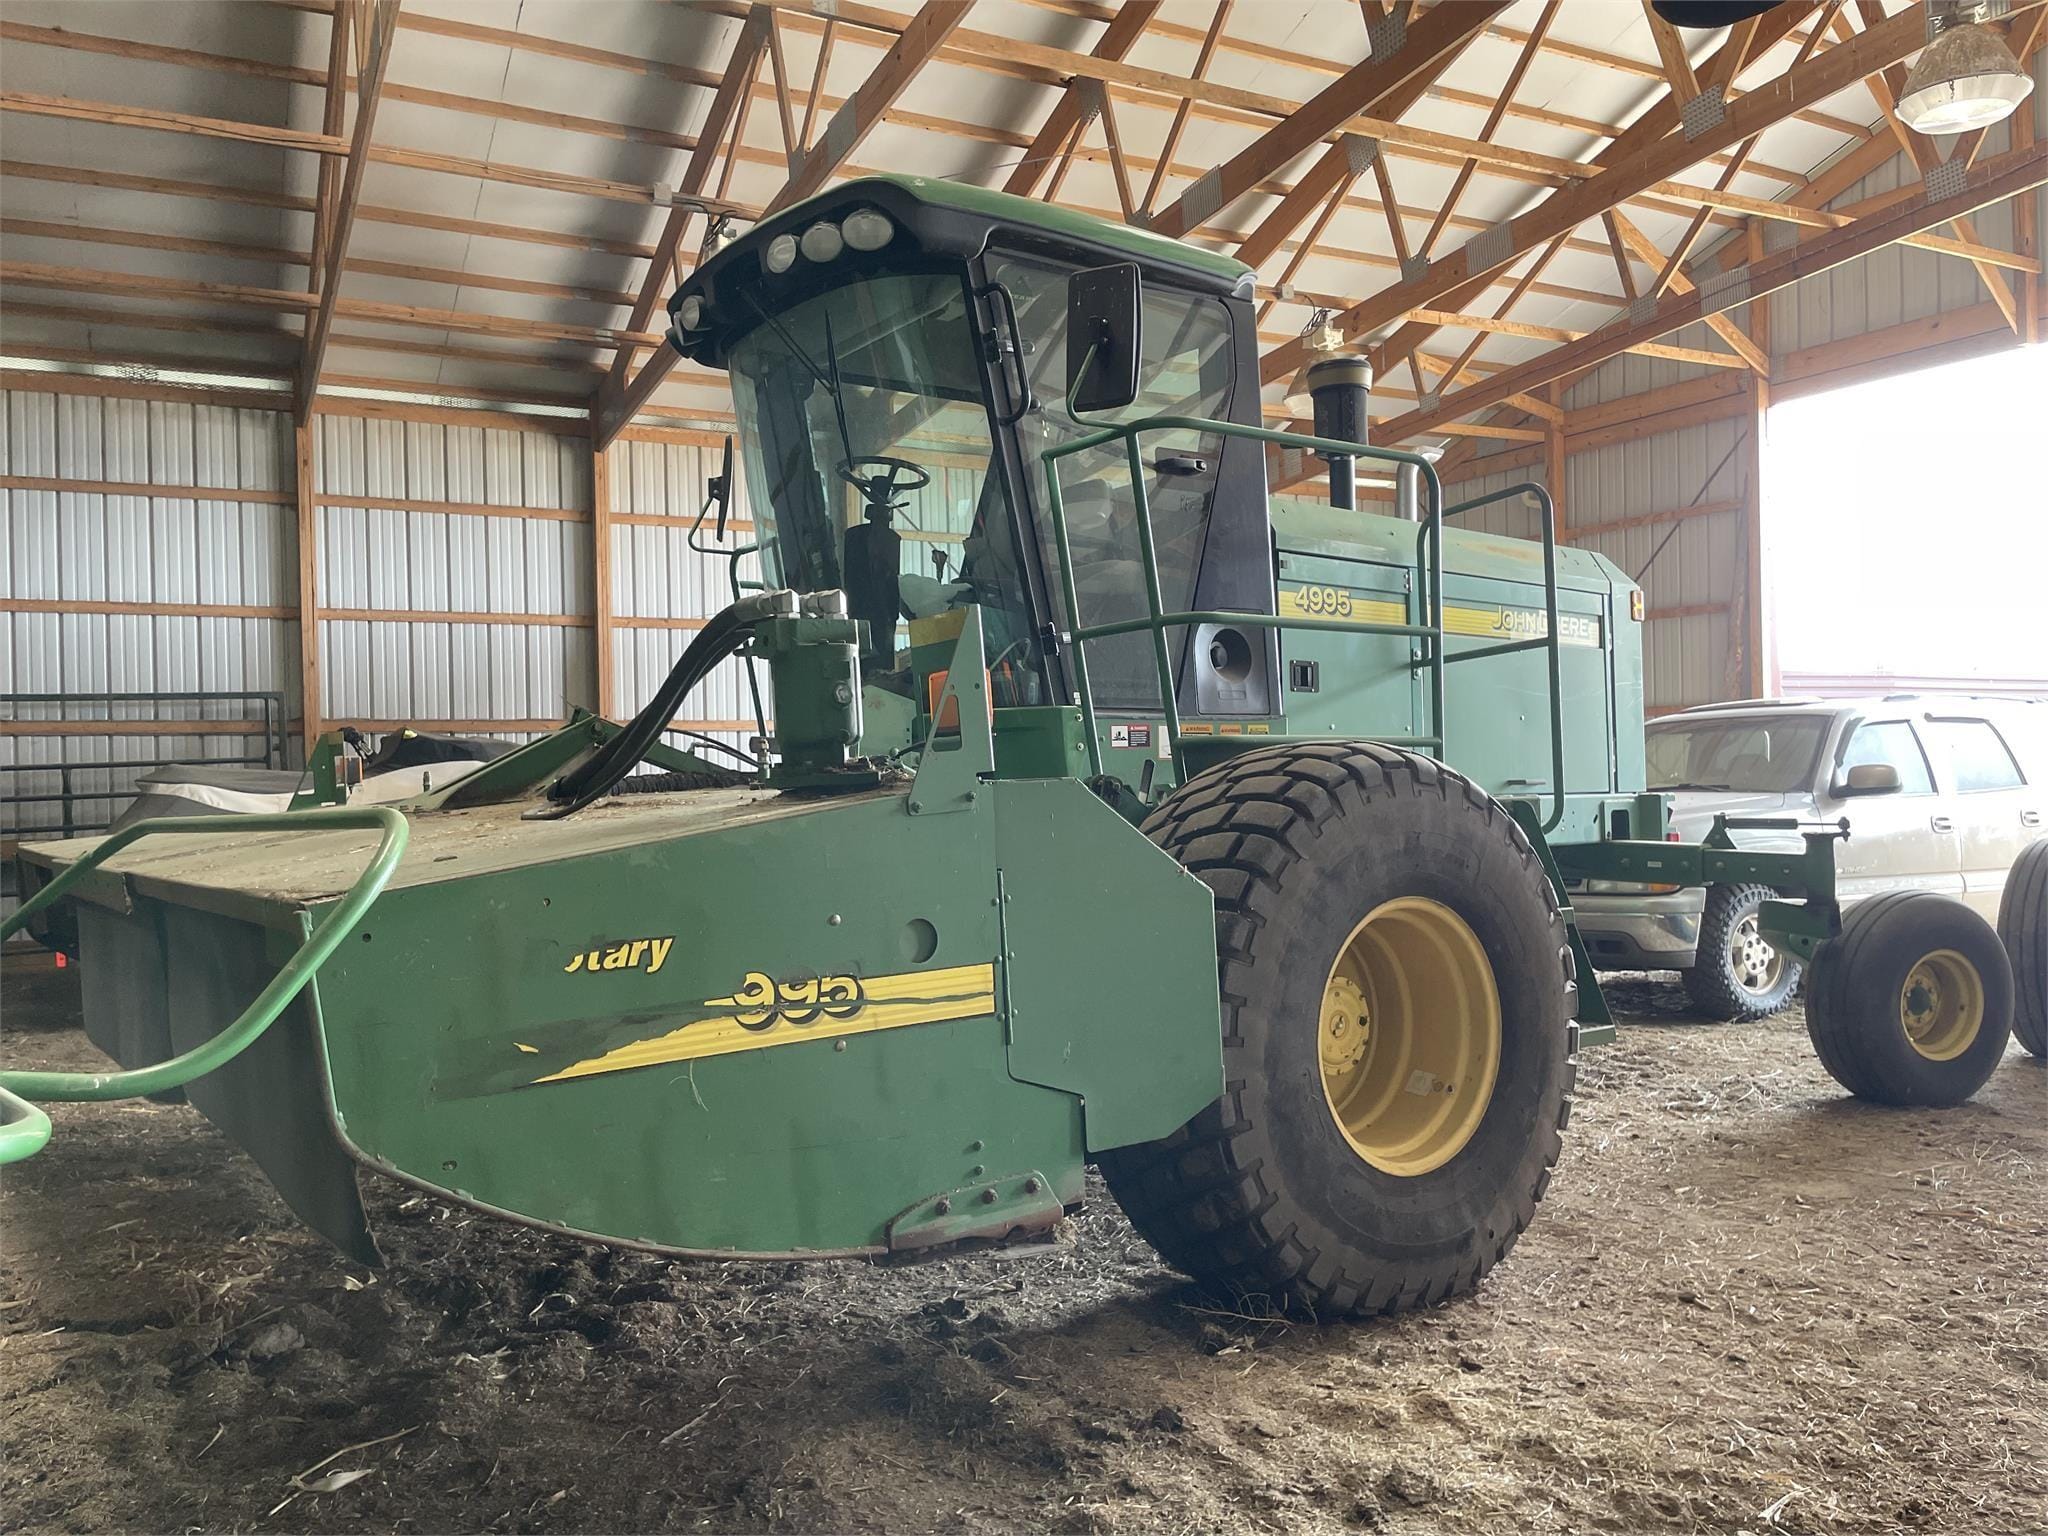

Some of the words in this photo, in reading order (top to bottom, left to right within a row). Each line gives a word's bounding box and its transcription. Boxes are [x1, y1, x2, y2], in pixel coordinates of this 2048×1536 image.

[1295, 585, 1352, 617] 4995
[1492, 605, 1538, 634] JOHN
[1539, 610, 1590, 638] DERE
[734, 971, 864, 1031] 995
